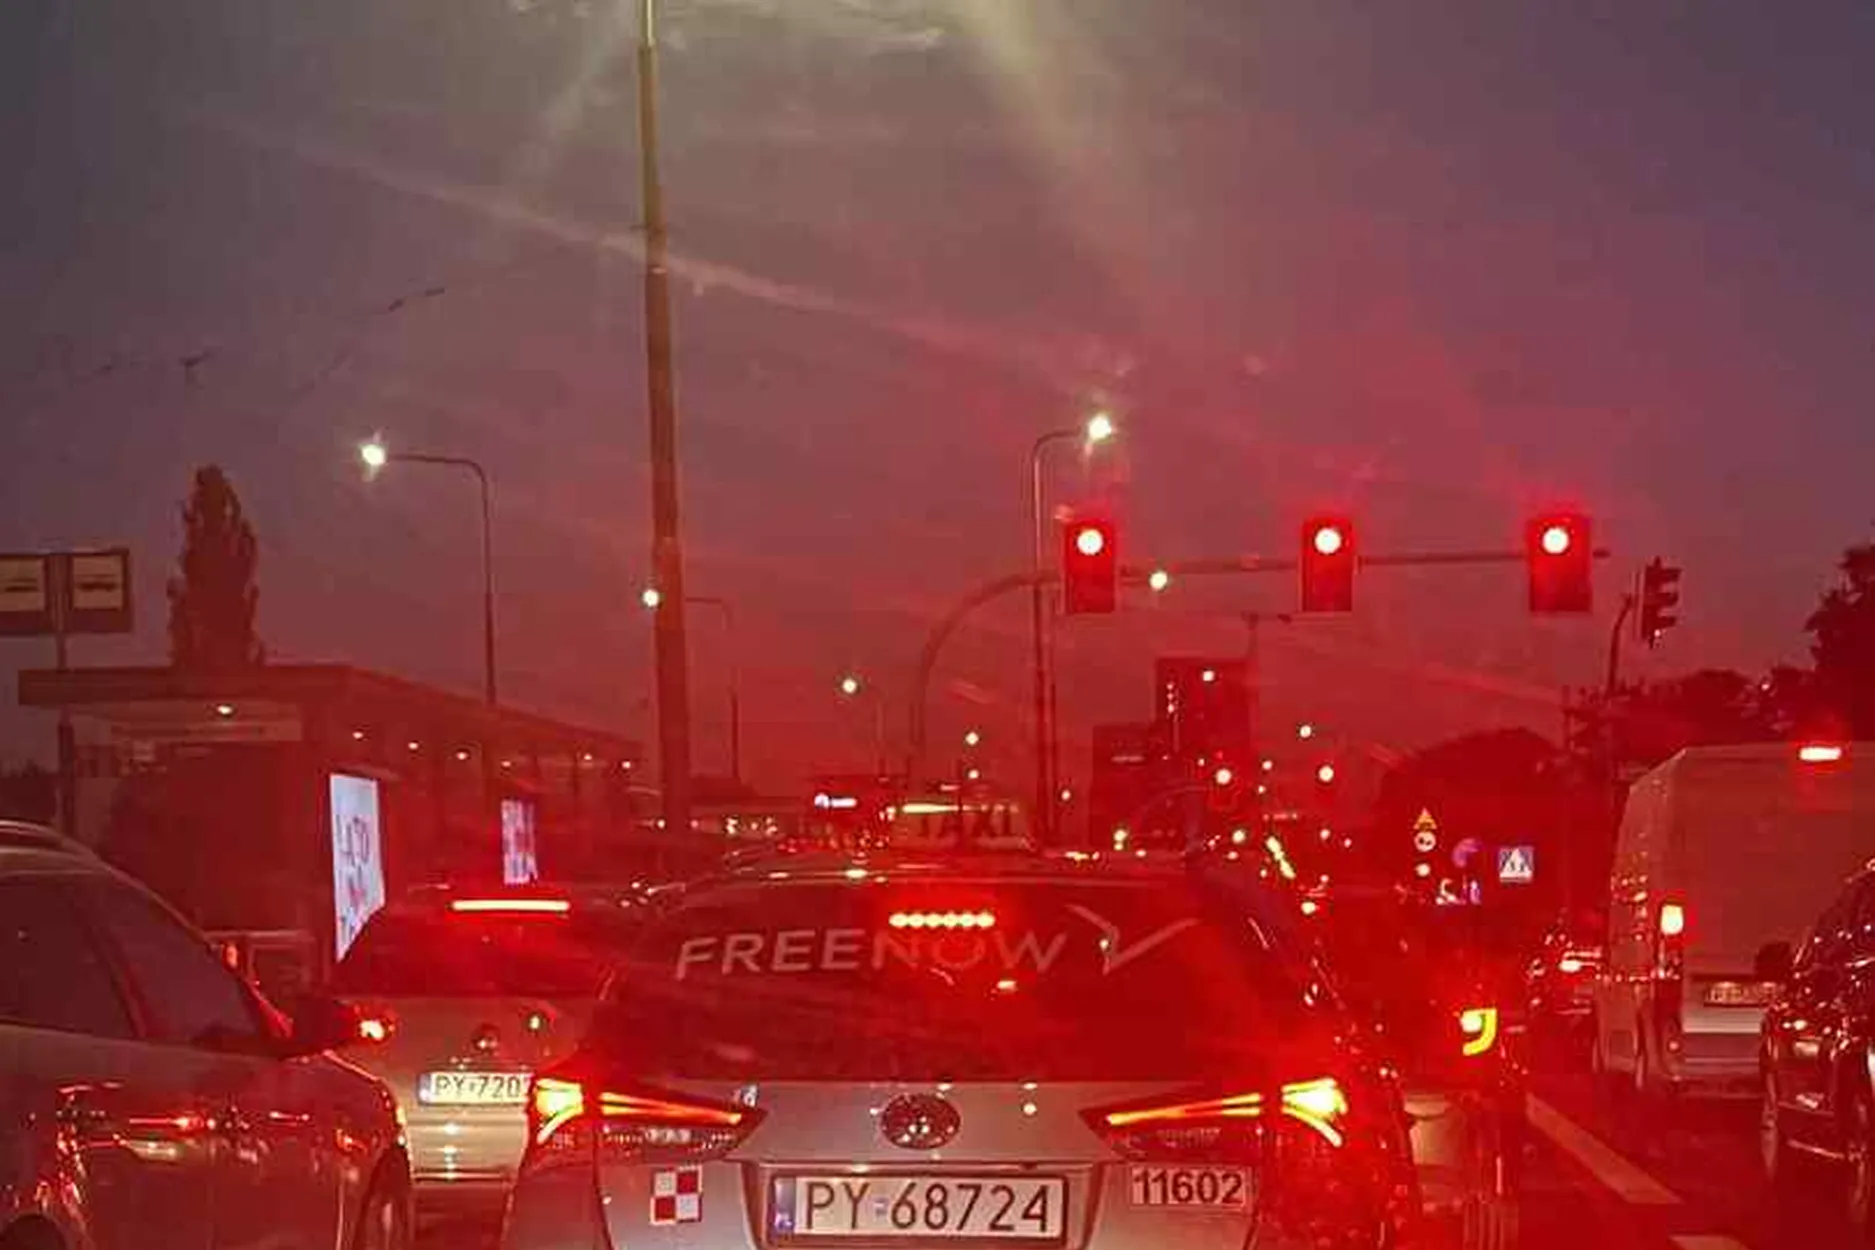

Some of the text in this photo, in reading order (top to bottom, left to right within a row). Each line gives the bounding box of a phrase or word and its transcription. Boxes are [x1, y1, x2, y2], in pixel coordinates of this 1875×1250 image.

[434, 1075, 465, 1097] PY
[1132, 1168, 1243, 1204] 11602
[804, 1181, 1048, 1232] PY 68724
